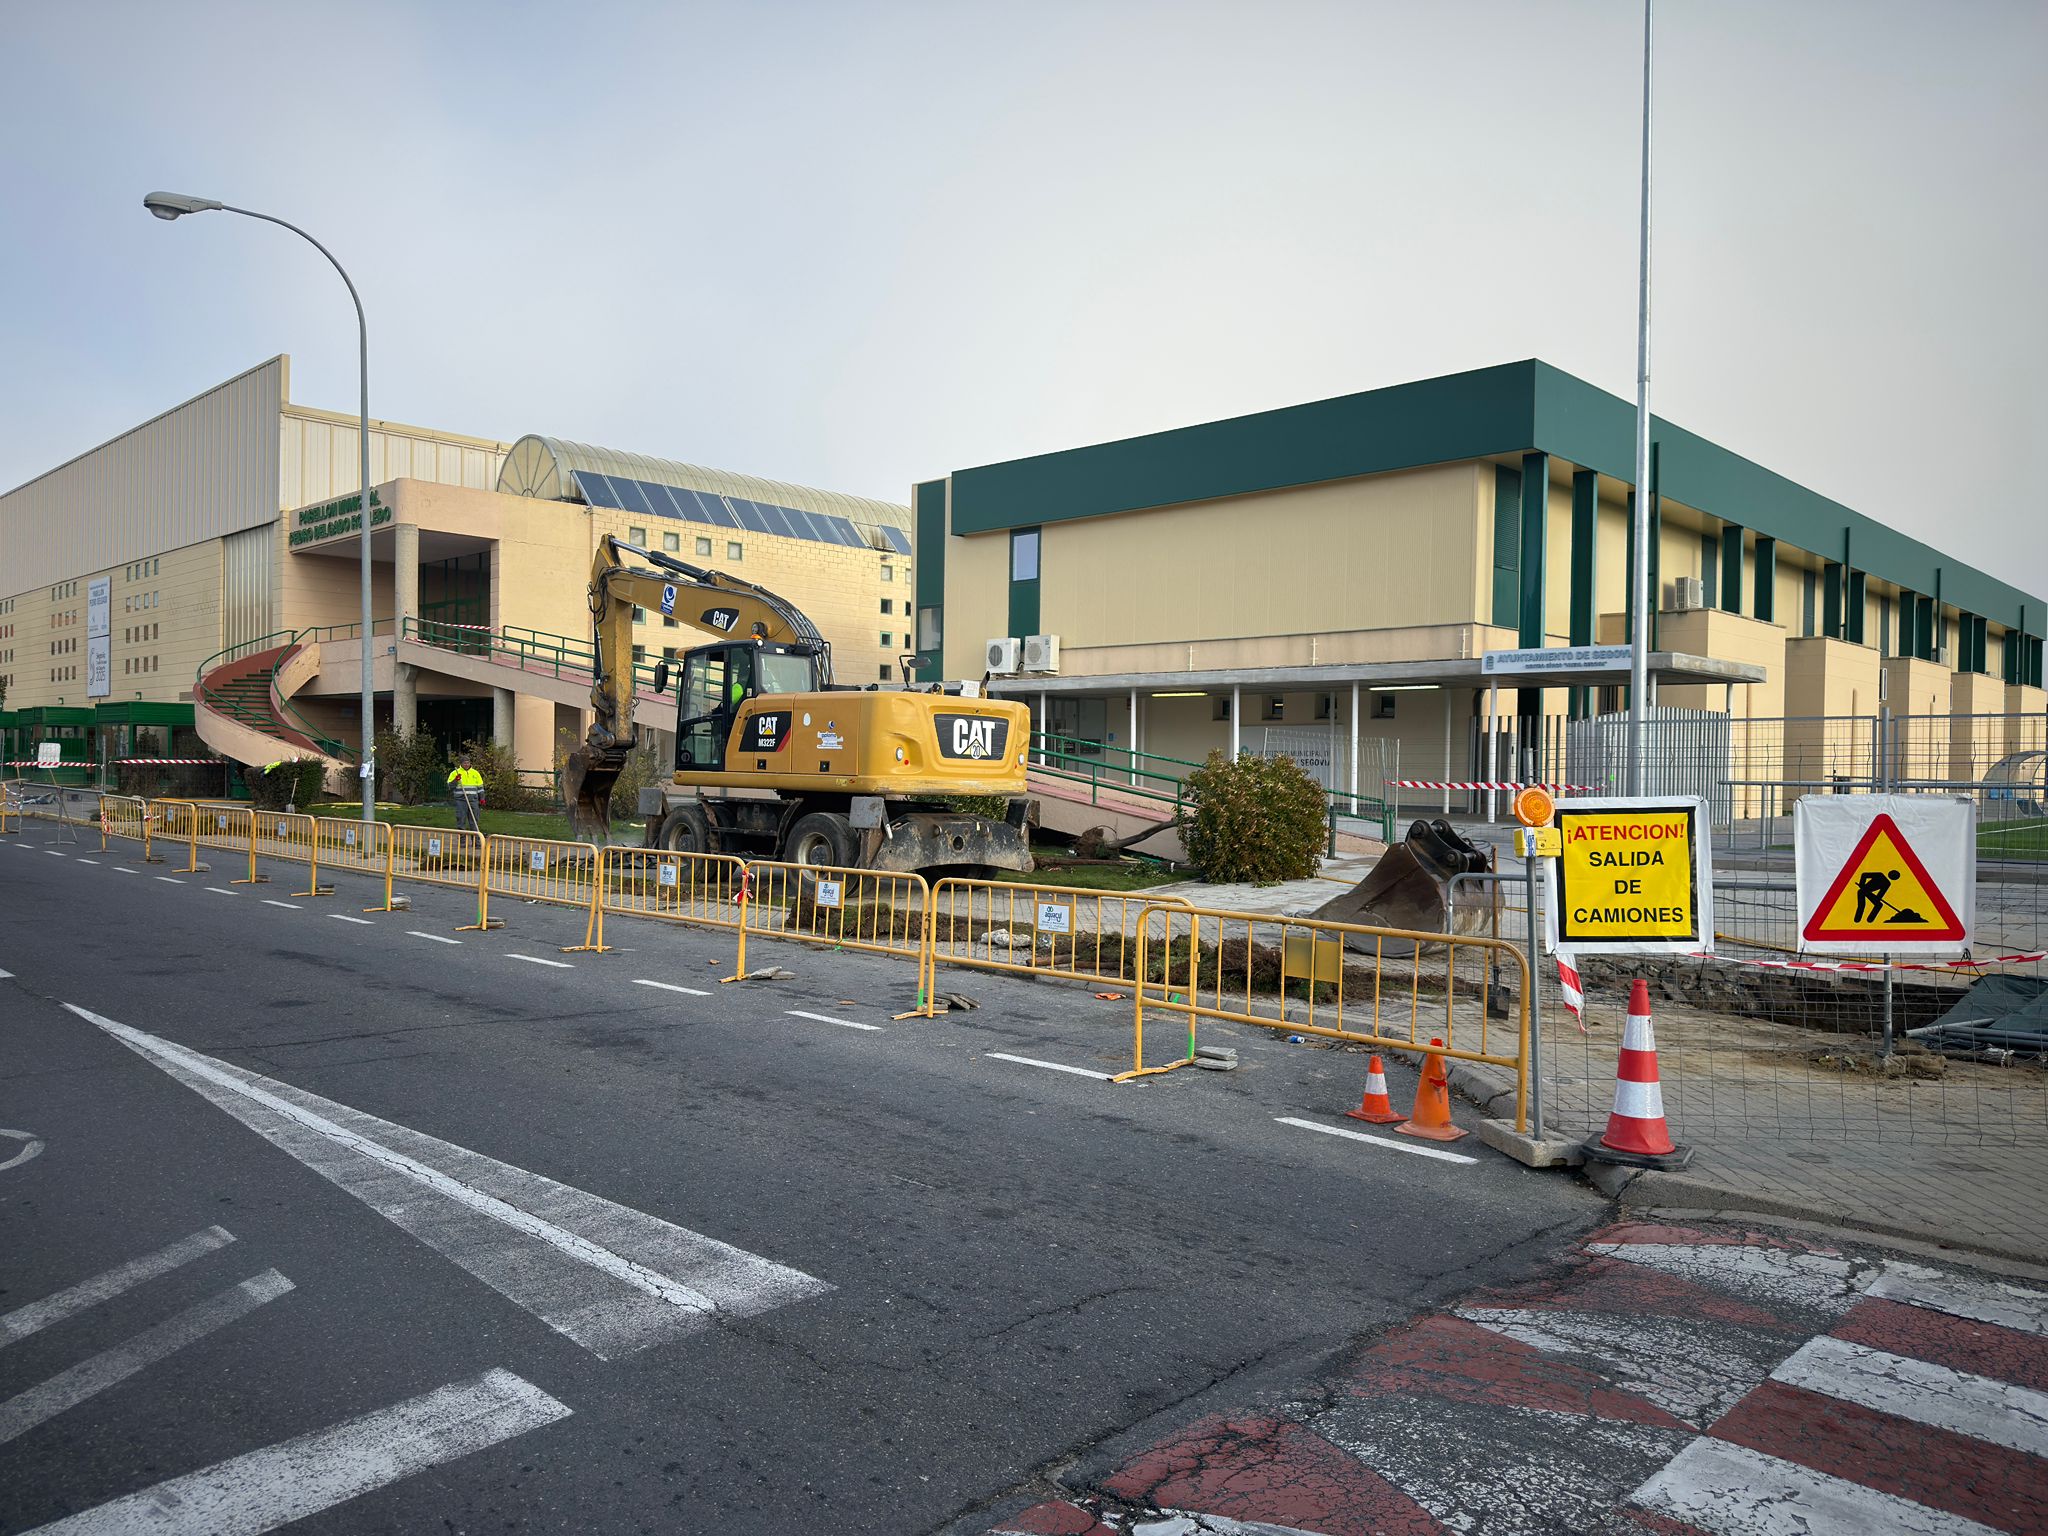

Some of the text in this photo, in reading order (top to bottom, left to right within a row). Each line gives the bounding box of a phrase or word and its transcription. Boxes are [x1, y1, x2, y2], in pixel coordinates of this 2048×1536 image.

[289, 506, 392, 546] PEDRO DELGADO ROLEDO
[712, 610, 729, 630] CAT
[1497, 650, 1574, 663] AYUNTAMIENTO
[1575, 651, 1590, 661] DE
[758, 716, 778, 735] CAT
[758, 738, 776, 747] M322F
[953, 718, 996, 757] CAT
[972, 745, 981, 758] 20
[1567, 823, 1685, 844] ¡ATENCION!
[1589, 850, 1665, 867] SALIDA
[1614, 879, 1642, 895] DE
[1573, 907, 1684, 923] CAMIONES
